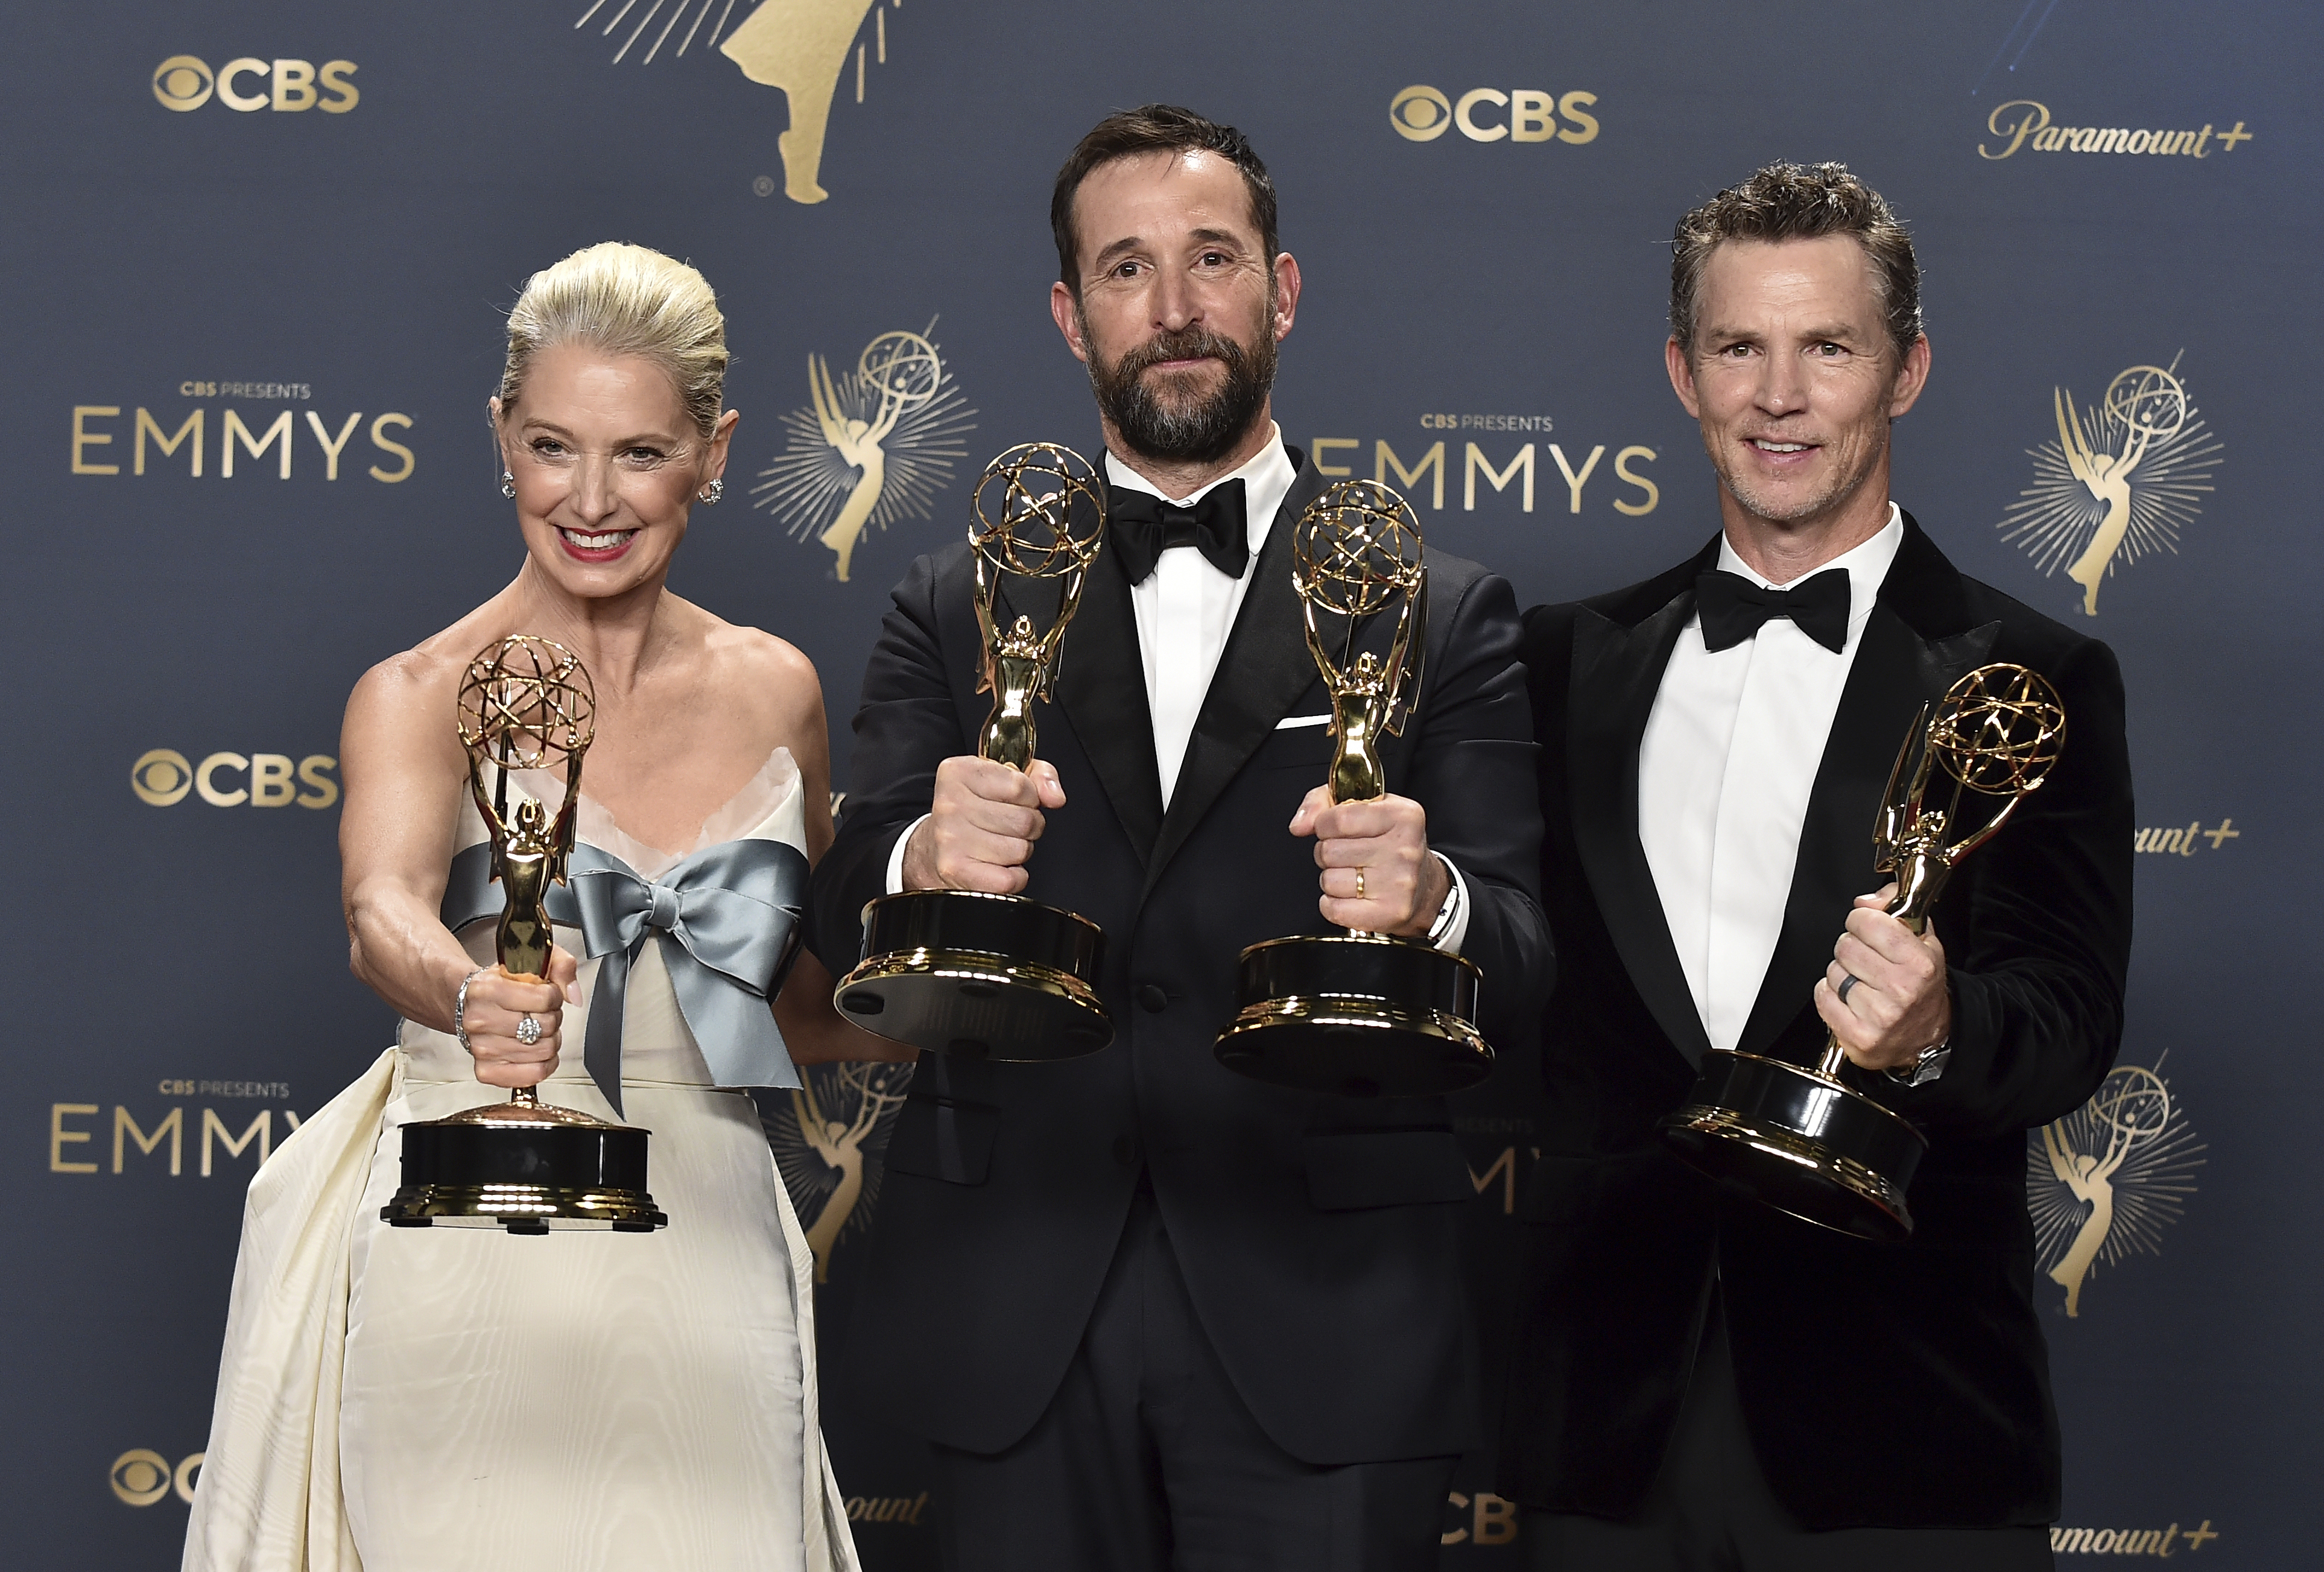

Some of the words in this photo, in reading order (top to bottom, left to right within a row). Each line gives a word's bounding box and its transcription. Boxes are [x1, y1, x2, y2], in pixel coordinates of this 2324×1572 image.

[217, 57, 359, 113] CBS
[1454, 87, 1600, 145] CBS
[1978, 100, 2253, 159] Paramount+
[180, 381, 217, 398] CBS
[221, 382, 311, 400] PRESENTS
[71, 406, 416, 484] EMMYS
[1420, 413, 1457, 429] CBS
[1461, 414, 1553, 432] PRESENTS
[1311, 438, 1659, 516] EMMYS
[195, 752, 338, 809] CBS
[159, 1080, 195, 1095] CBS
[198, 1080, 290, 1098] PRESENTS
[51, 1103, 300, 1176] EMM
[842, 1491, 929, 1526] ount
